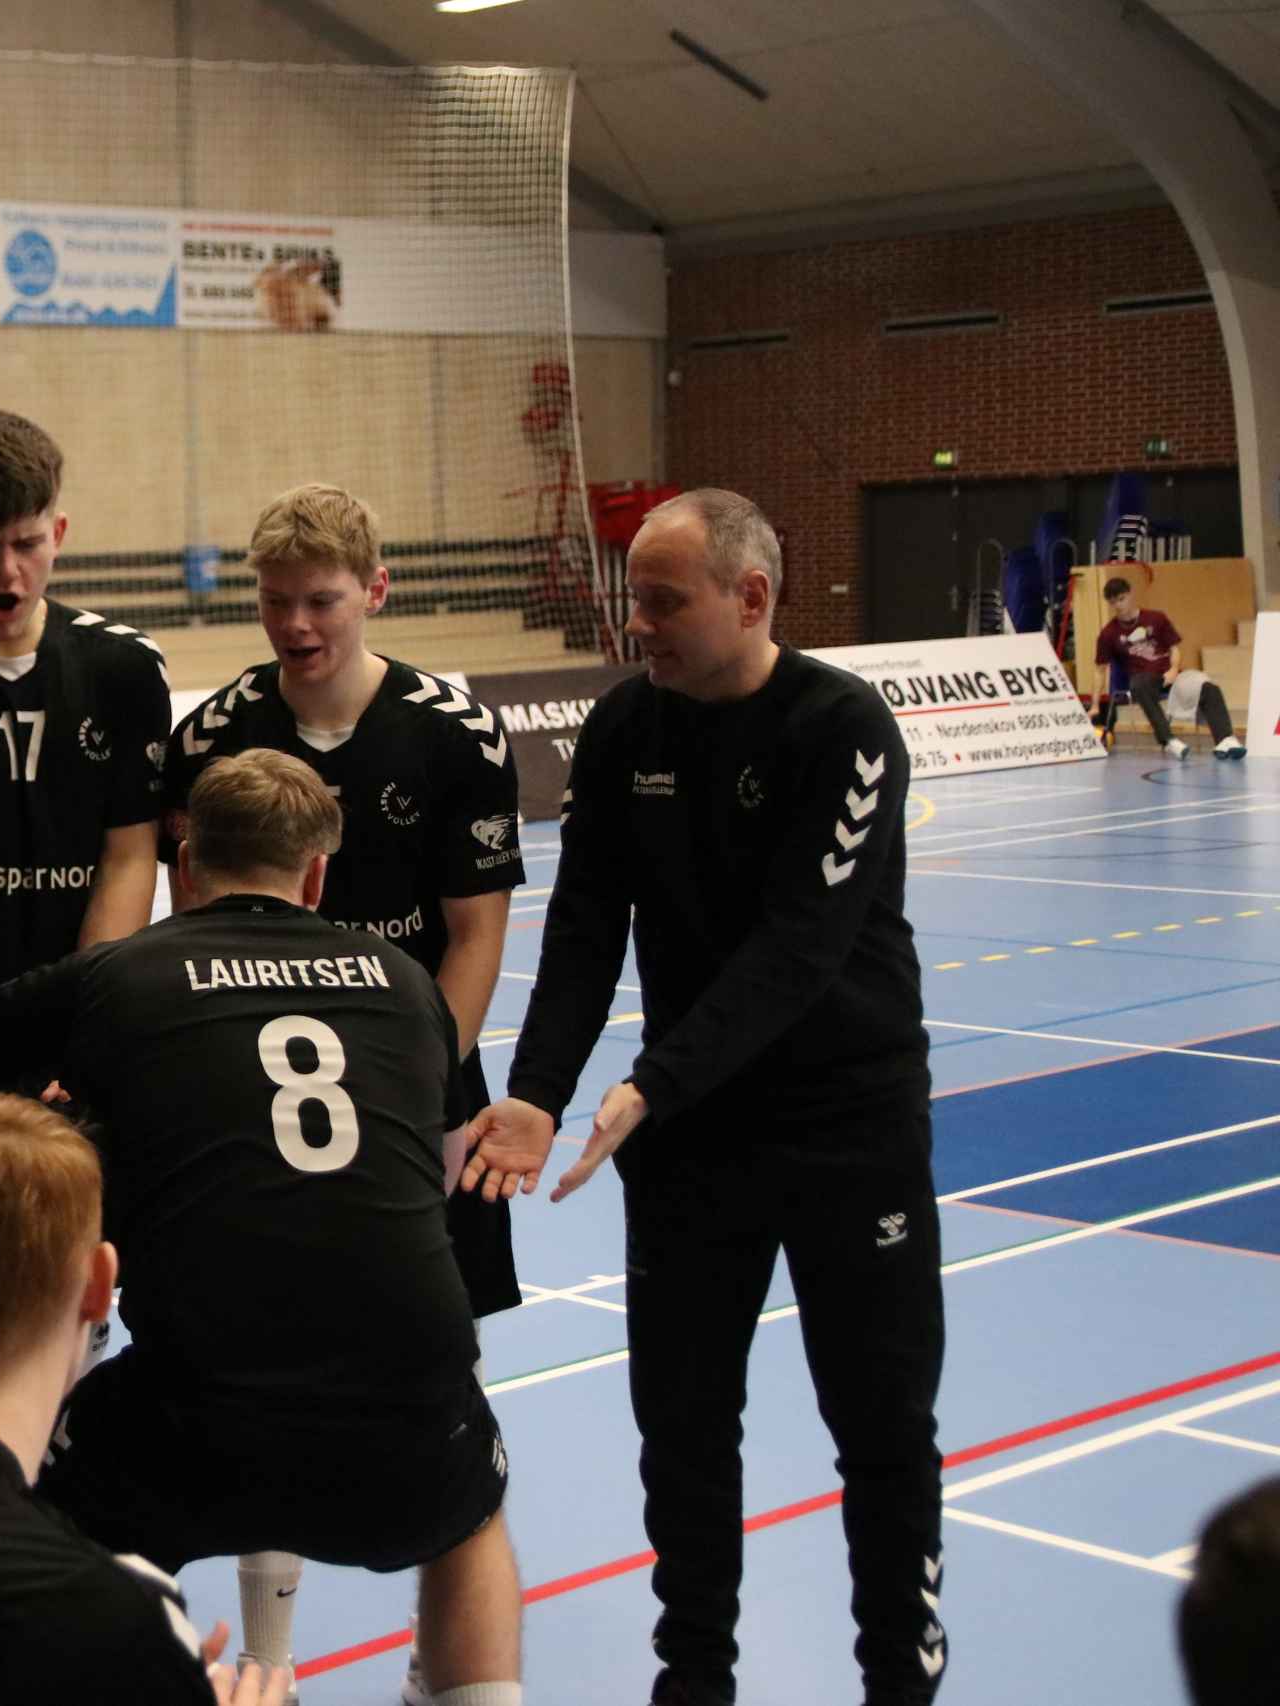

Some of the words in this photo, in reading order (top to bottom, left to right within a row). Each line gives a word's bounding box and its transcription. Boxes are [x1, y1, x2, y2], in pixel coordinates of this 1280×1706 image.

[871, 671, 1000, 707] ØJVANG
[999, 664, 1058, 696] BYG
[184, 955, 391, 991] LAURITSEN
[257, 1014, 360, 1173] 8
